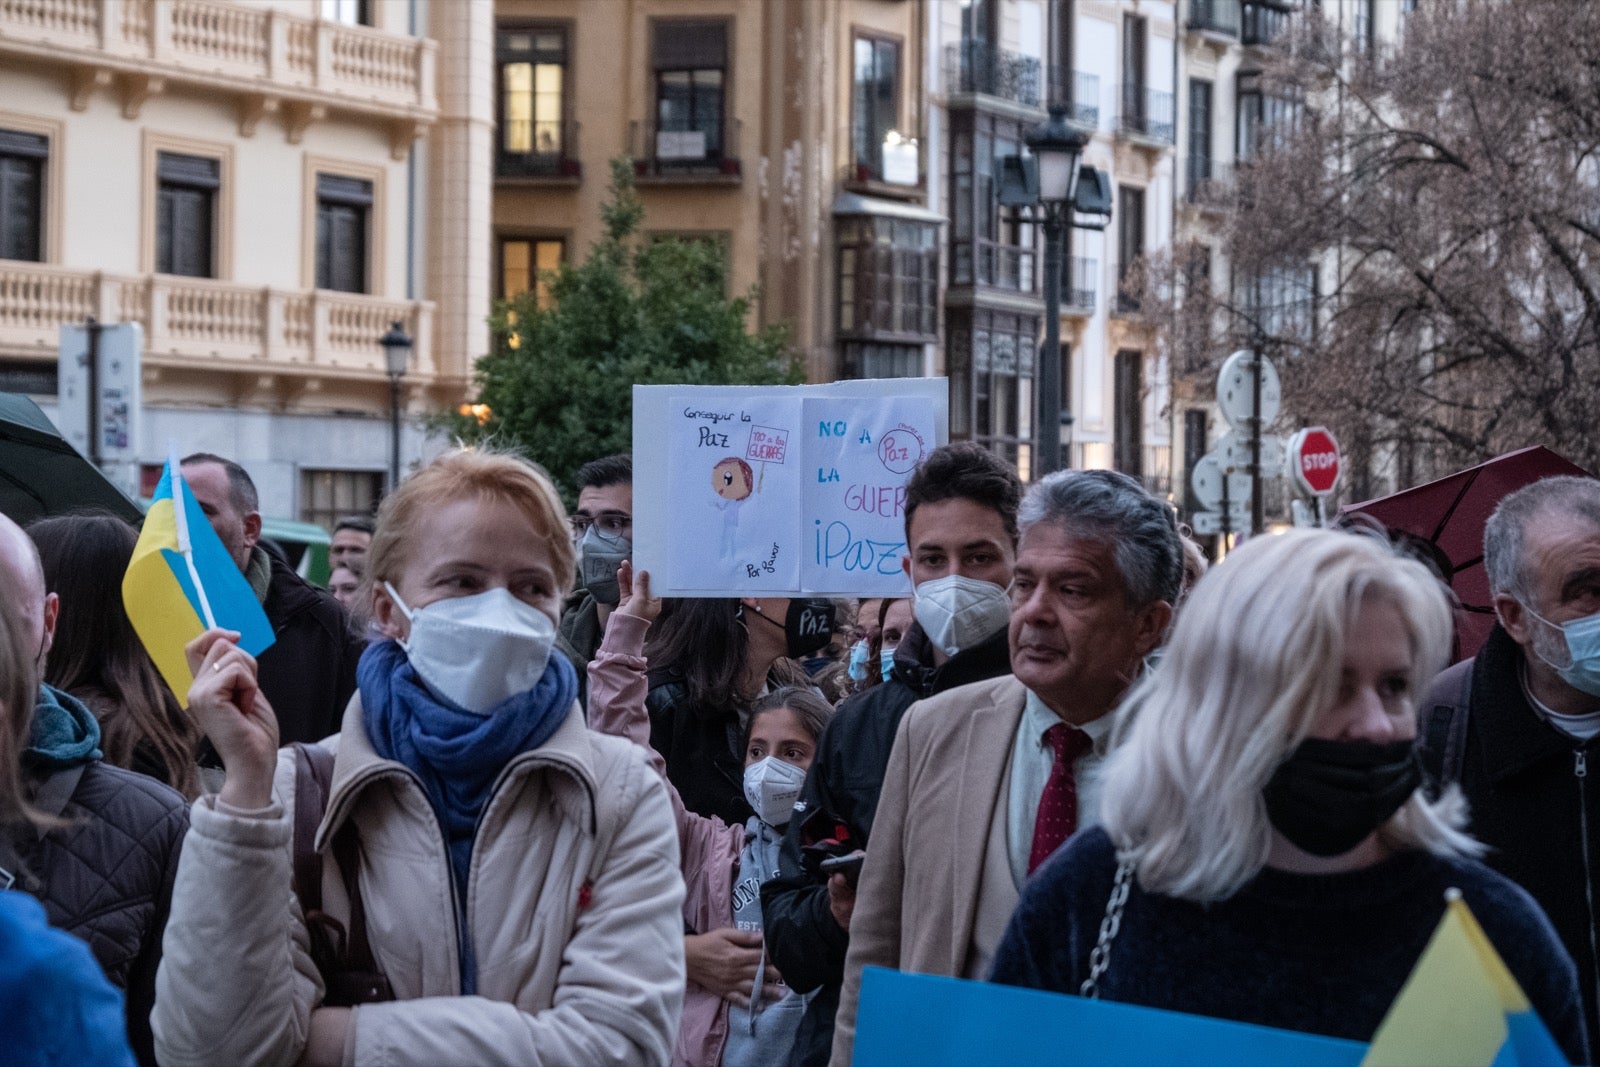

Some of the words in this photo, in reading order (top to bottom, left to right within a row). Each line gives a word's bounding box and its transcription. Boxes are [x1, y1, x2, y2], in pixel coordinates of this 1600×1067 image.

[683, 407, 735, 425] Conseguir
[740, 410, 752, 423] la
[698, 426, 730, 448] Paz
[819, 421, 847, 437] NO
[858, 428, 872, 444] A
[883, 436, 909, 465] Paz
[1303, 451, 1337, 471] STOP
[817, 467, 840, 483] LA
[746, 563, 761, 578] Por
[800, 608, 830, 636] PAZ
